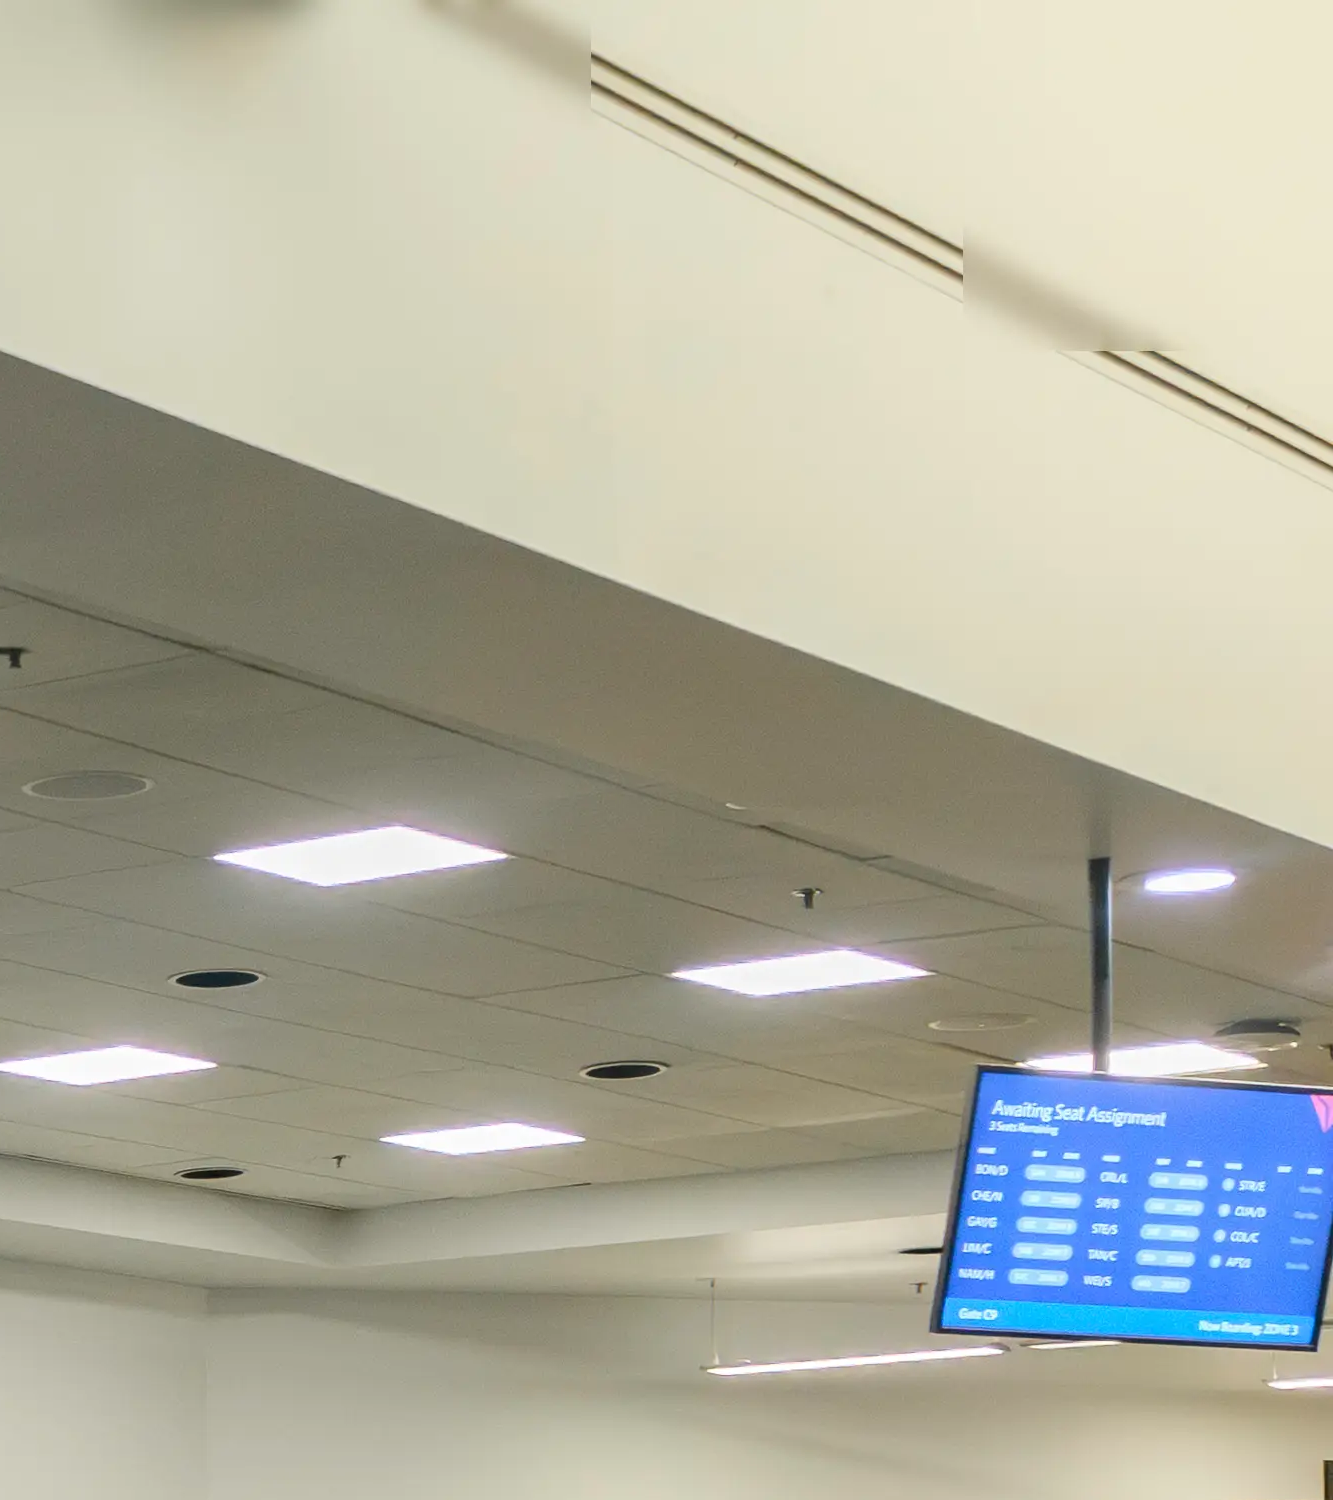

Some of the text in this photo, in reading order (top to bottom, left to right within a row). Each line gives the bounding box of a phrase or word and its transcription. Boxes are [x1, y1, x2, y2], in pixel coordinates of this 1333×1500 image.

[991, 1099, 1167, 1128] Awaiting Seat Assignment
